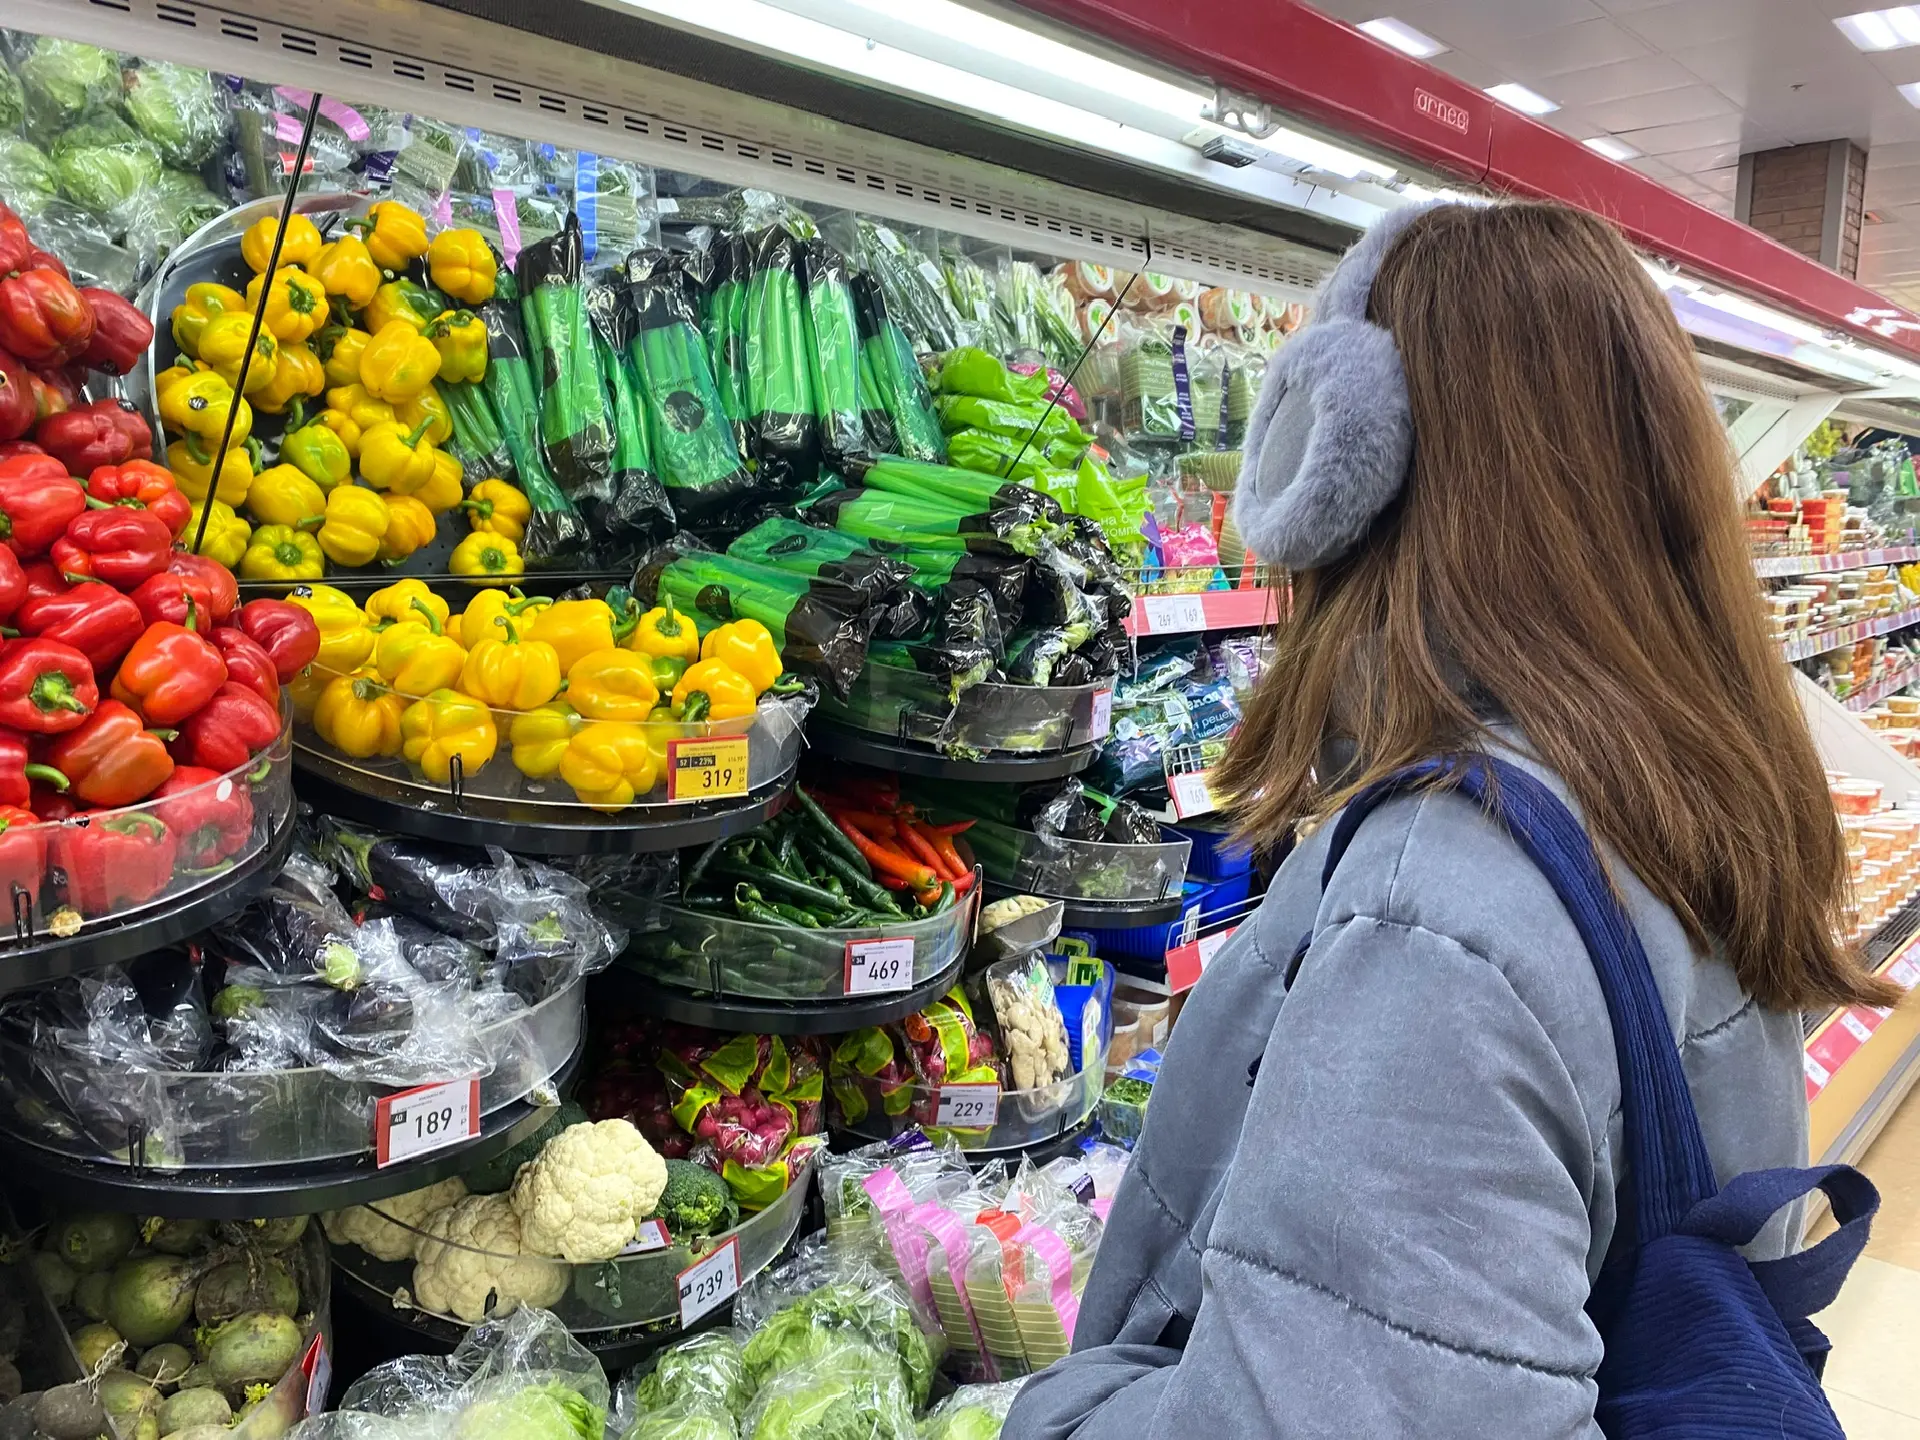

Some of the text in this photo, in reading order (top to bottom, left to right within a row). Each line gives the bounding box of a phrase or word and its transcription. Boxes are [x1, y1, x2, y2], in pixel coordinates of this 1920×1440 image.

[702, 769, 732, 788] 319
[868, 960, 899, 981] 469
[953, 1102, 984, 1118] 229
[415, 1107, 452, 1138] 189
[696, 1269, 723, 1304] 239
